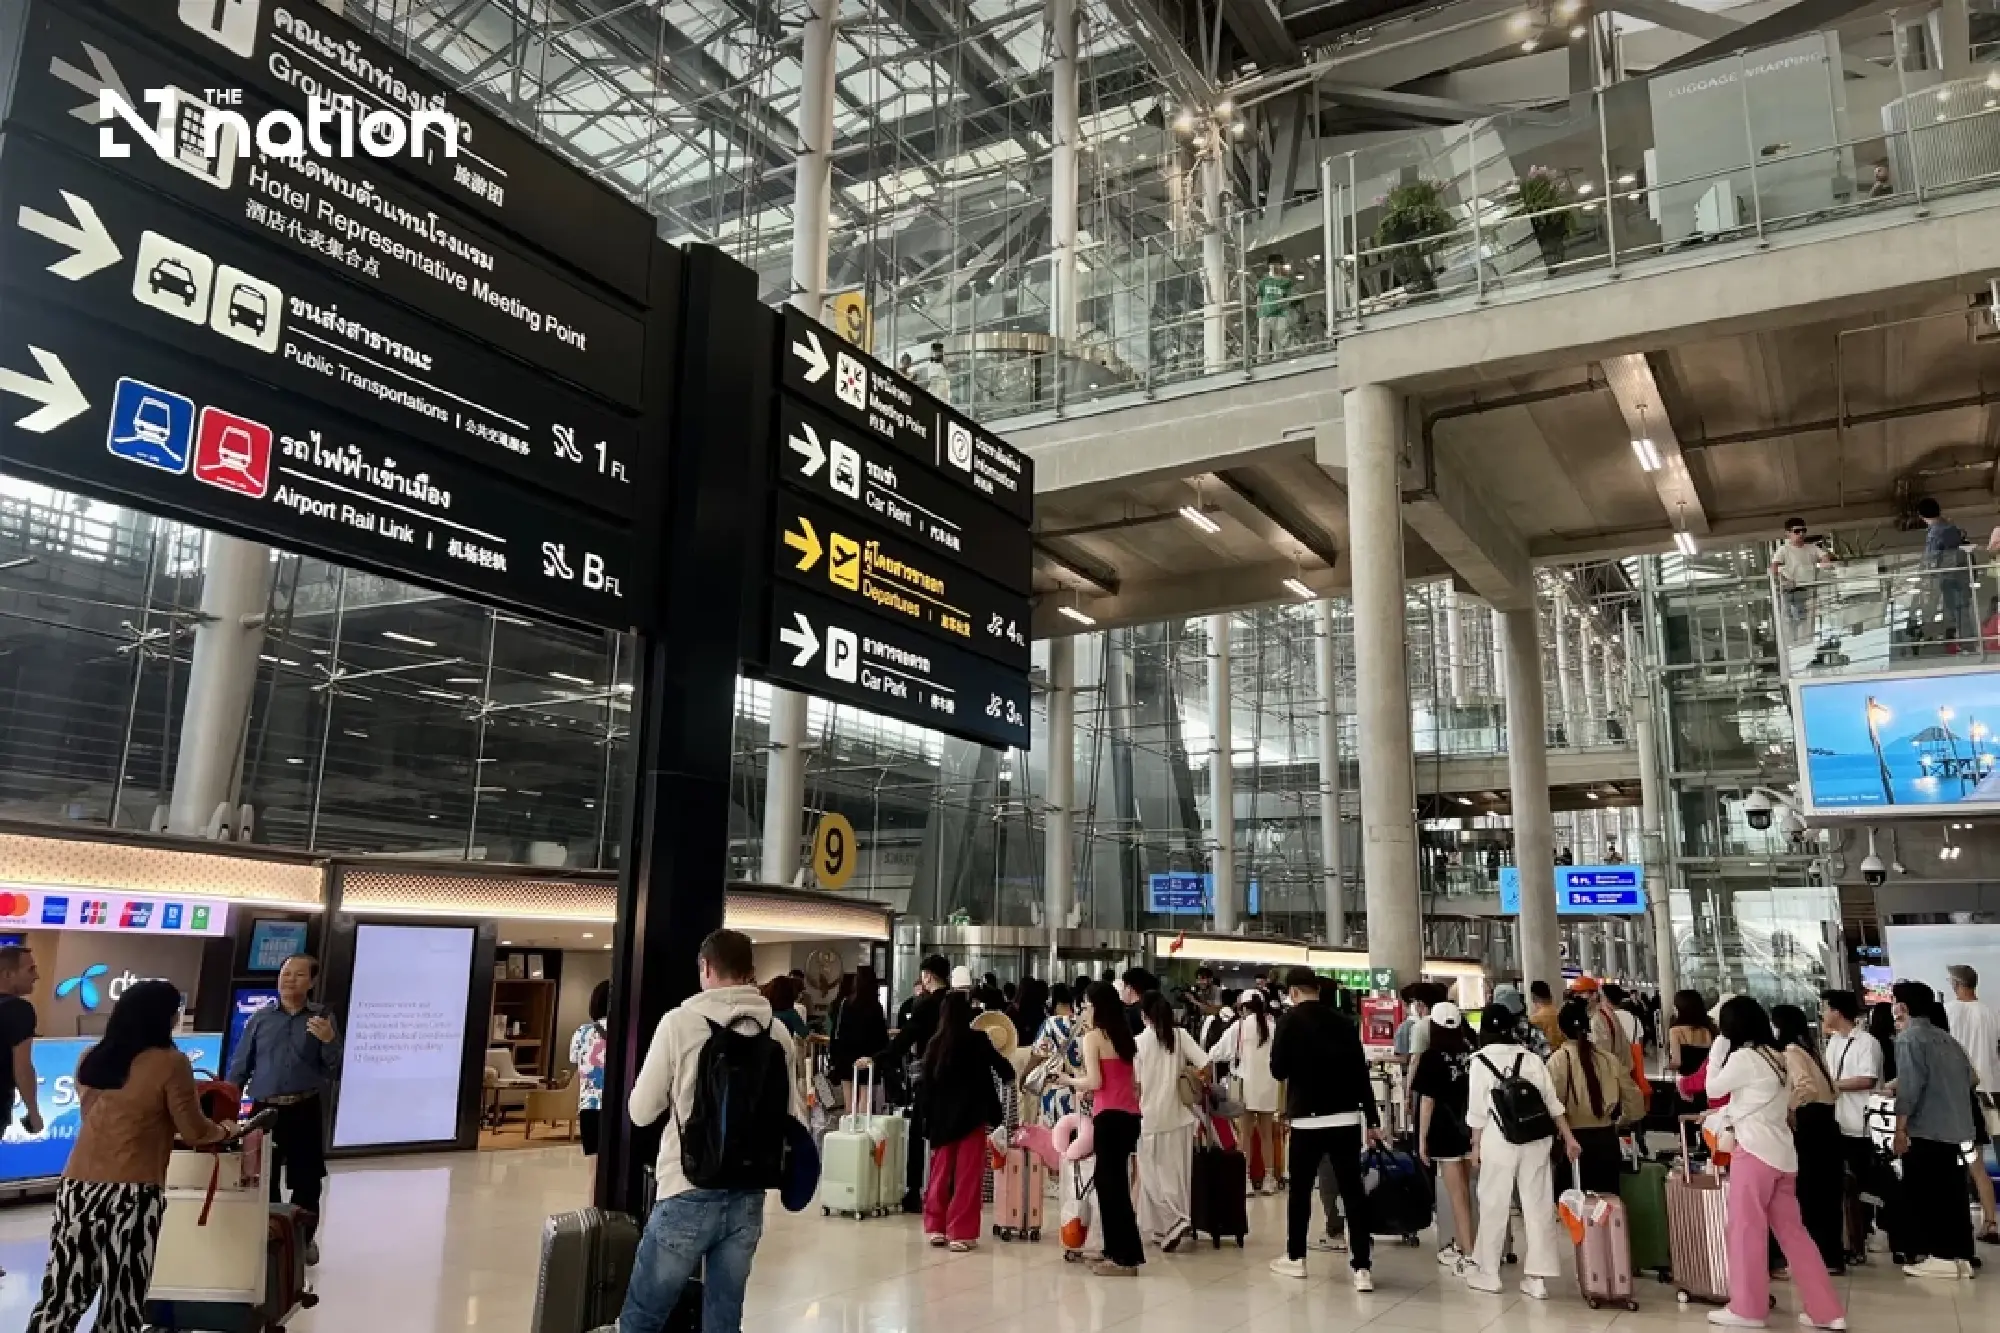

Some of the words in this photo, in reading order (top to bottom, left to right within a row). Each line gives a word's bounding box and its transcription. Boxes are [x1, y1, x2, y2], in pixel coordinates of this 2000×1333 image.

[249, 164, 311, 214] Hotel
[316, 198, 468, 291] Representative
[471, 277, 542, 332] Meeting
[545, 314, 587, 352] Point
[284, 342, 334, 377] Public
[338, 362, 449, 423] Transportations
[279, 429, 451, 509] รถไฟฟ้าเข้าเมือง
[272, 484, 338, 521] Airport
[341, 503, 375, 532] Rail
[379, 515, 415, 544] Link
[865, 490, 885, 513] Car
[862, 578, 921, 618] Departures
[834, 638, 849, 668] P
[860, 668, 881, 691] Car
[883, 675, 908, 699] Park
[824, 827, 844, 875] 9
